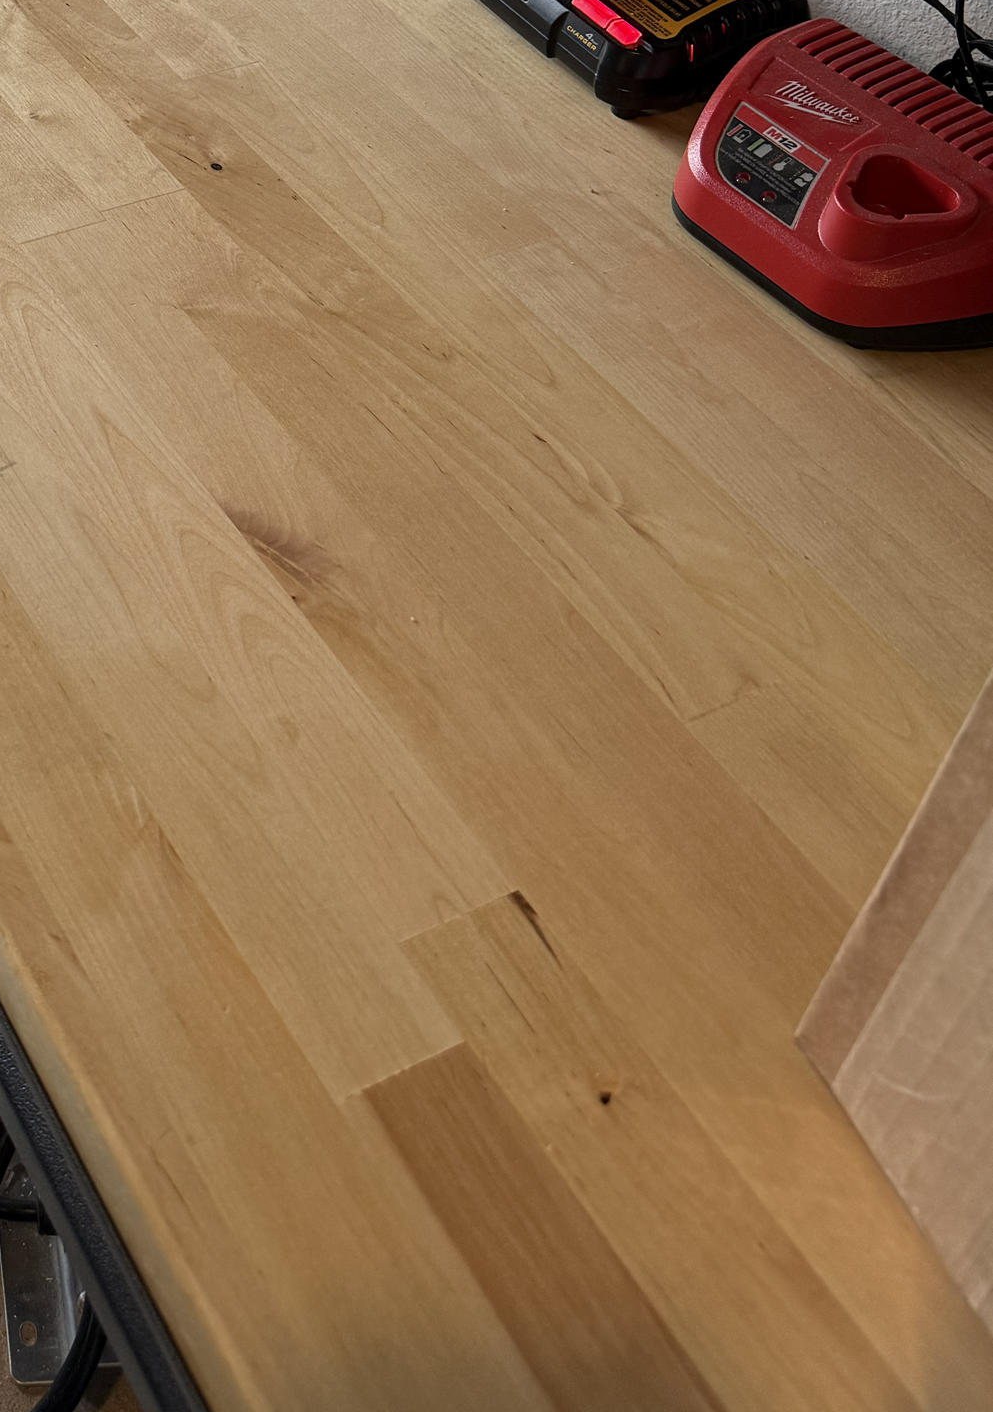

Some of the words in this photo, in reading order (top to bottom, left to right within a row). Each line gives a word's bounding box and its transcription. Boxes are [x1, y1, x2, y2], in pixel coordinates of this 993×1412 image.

[566, 26, 597, 52] CHARGER
[775, 80, 860, 124] Milwaukee
[765, 128, 798, 150] M12
